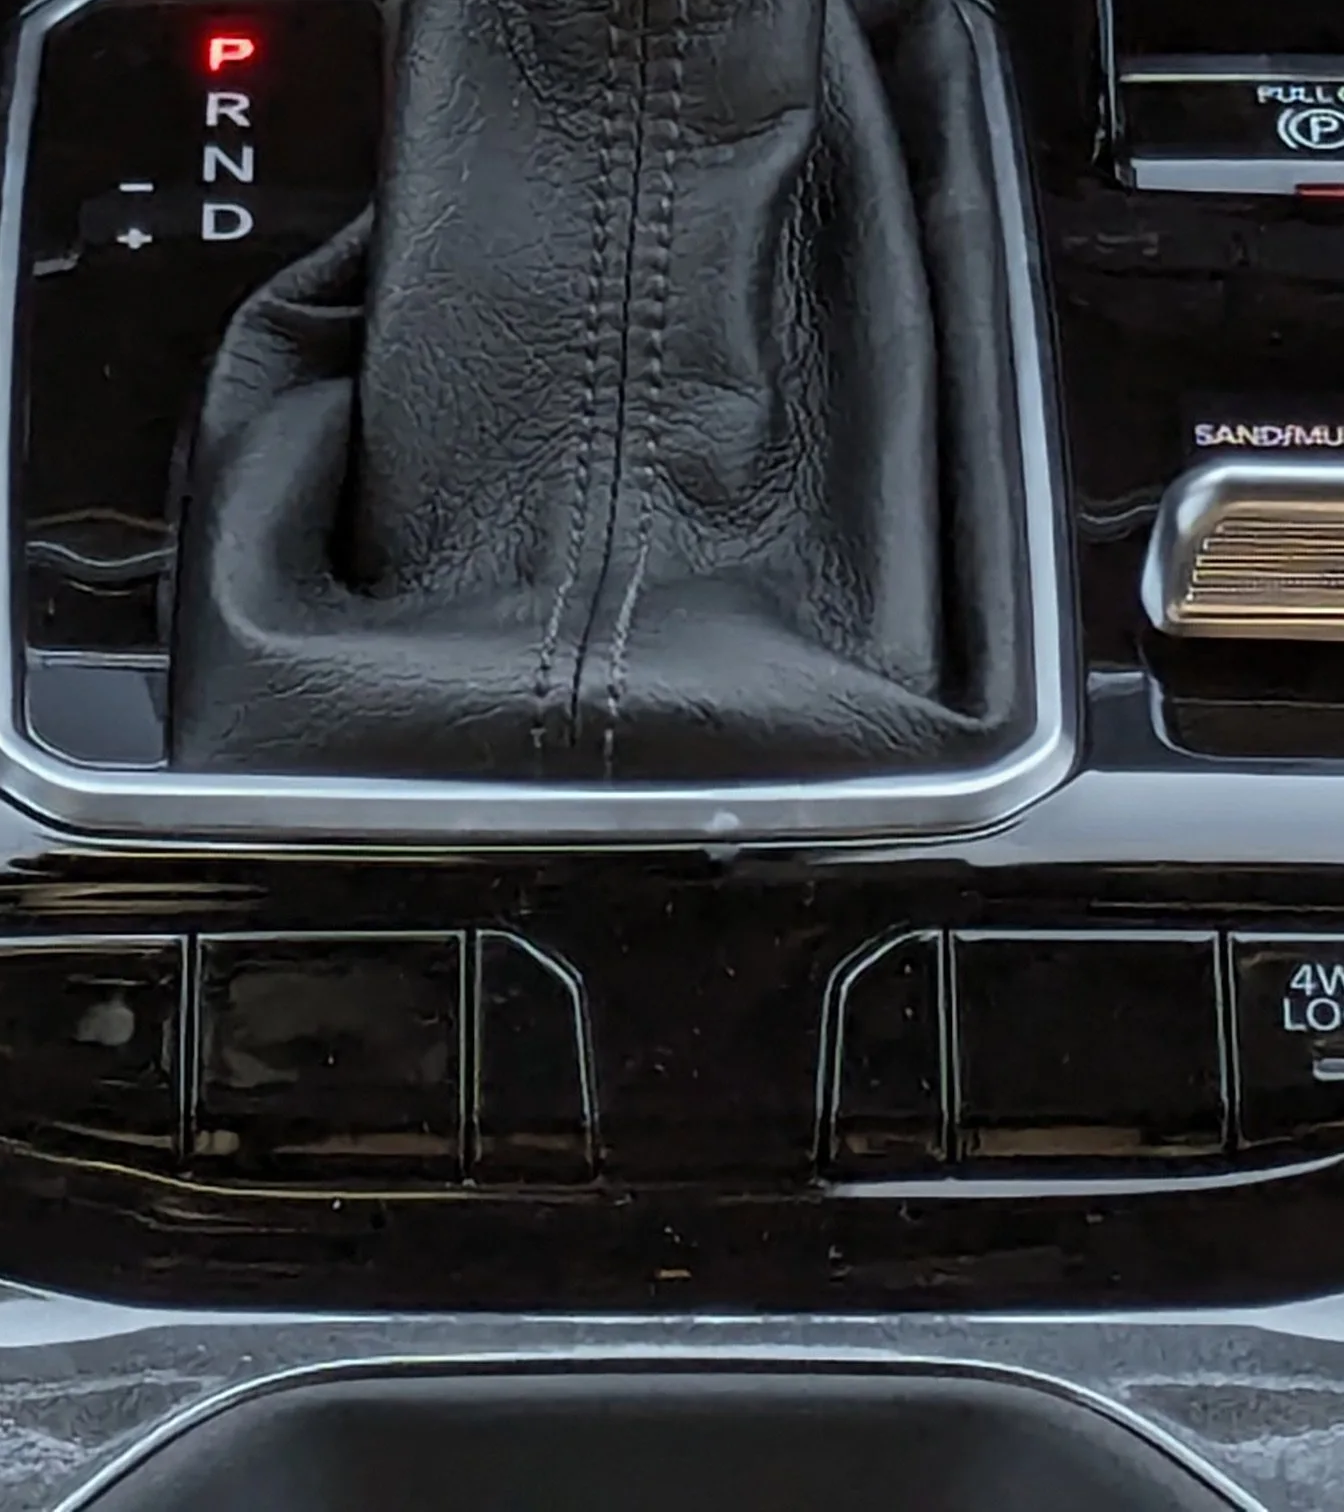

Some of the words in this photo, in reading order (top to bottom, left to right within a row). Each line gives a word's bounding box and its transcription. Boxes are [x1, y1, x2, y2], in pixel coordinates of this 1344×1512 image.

[208, 38, 255, 71] P
[206, 92, 251, 126] R
[1258, 86, 1333, 104] PULL
[203, 146, 254, 183] N
[202, 203, 254, 240] D
